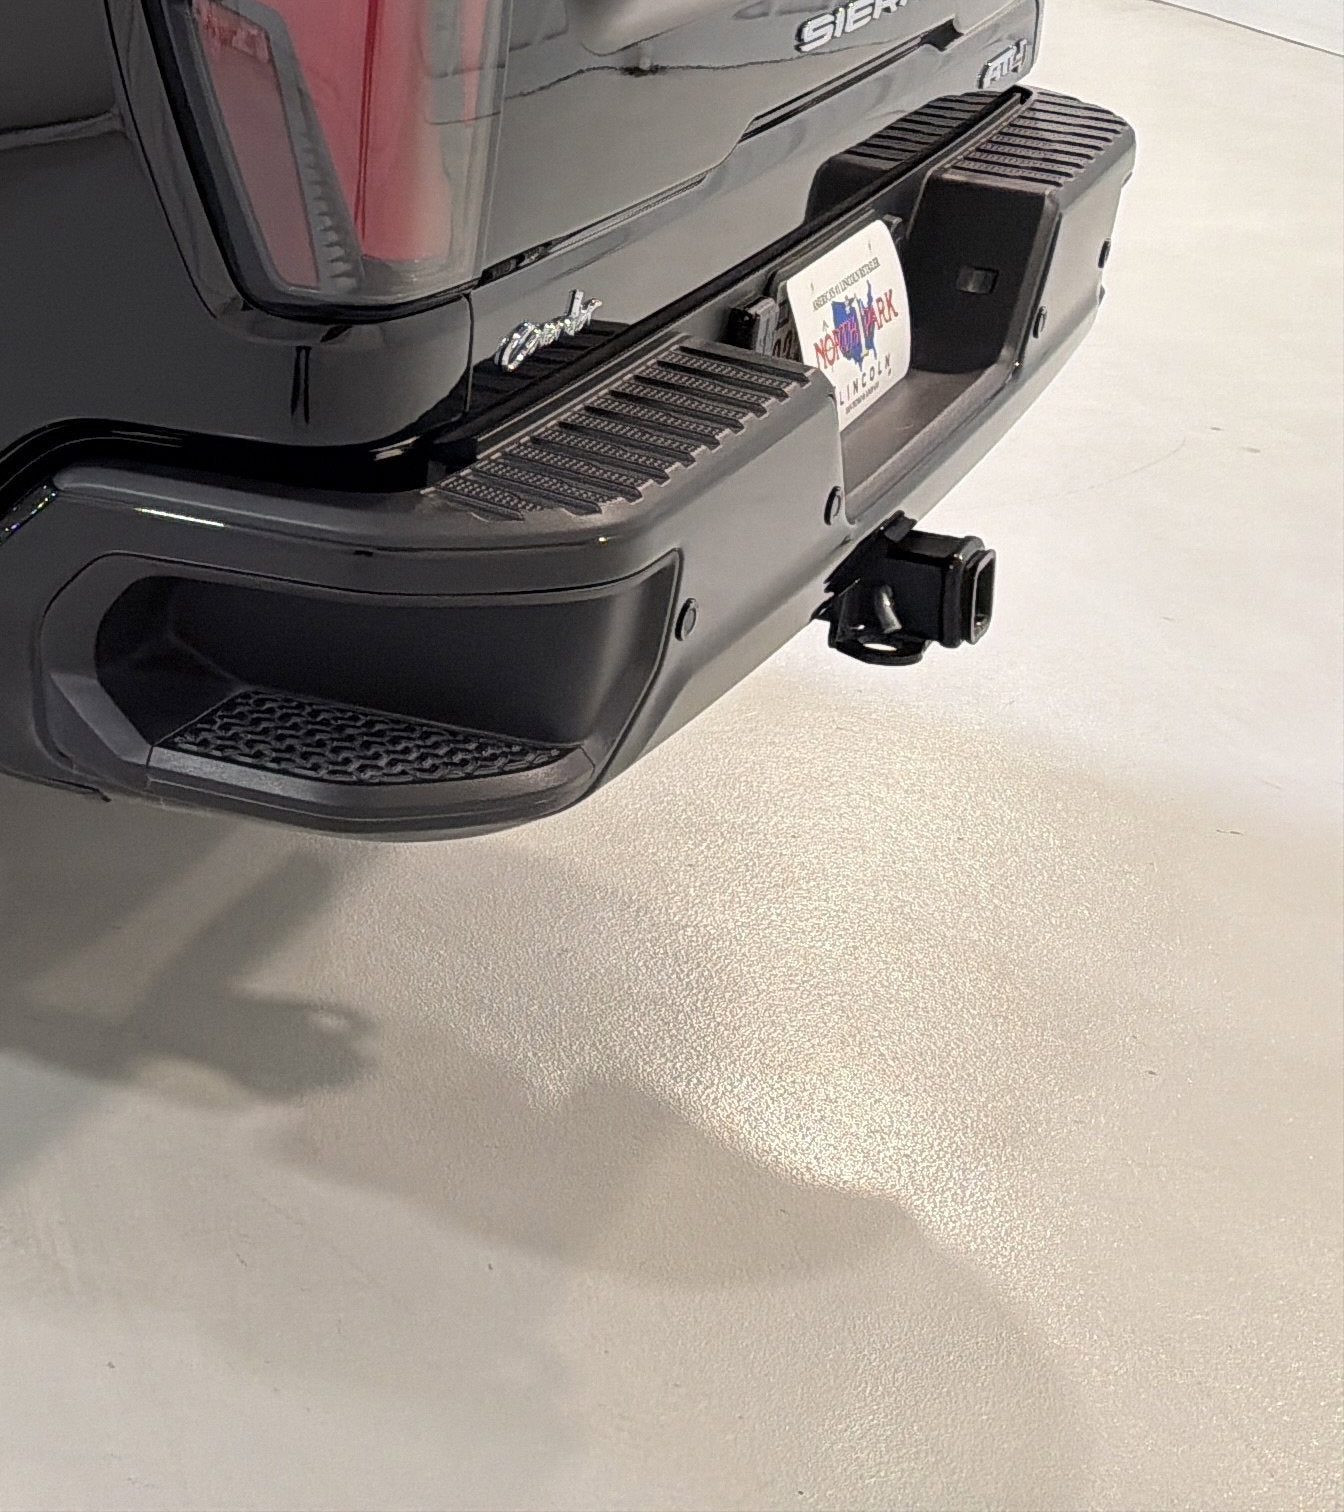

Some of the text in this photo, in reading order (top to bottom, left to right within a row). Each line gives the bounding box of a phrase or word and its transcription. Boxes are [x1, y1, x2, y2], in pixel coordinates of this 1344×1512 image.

[814, 316, 860, 369] NORTH
[862, 288, 899, 338] PARK
[839, 352, 891, 406] LINCOLN
